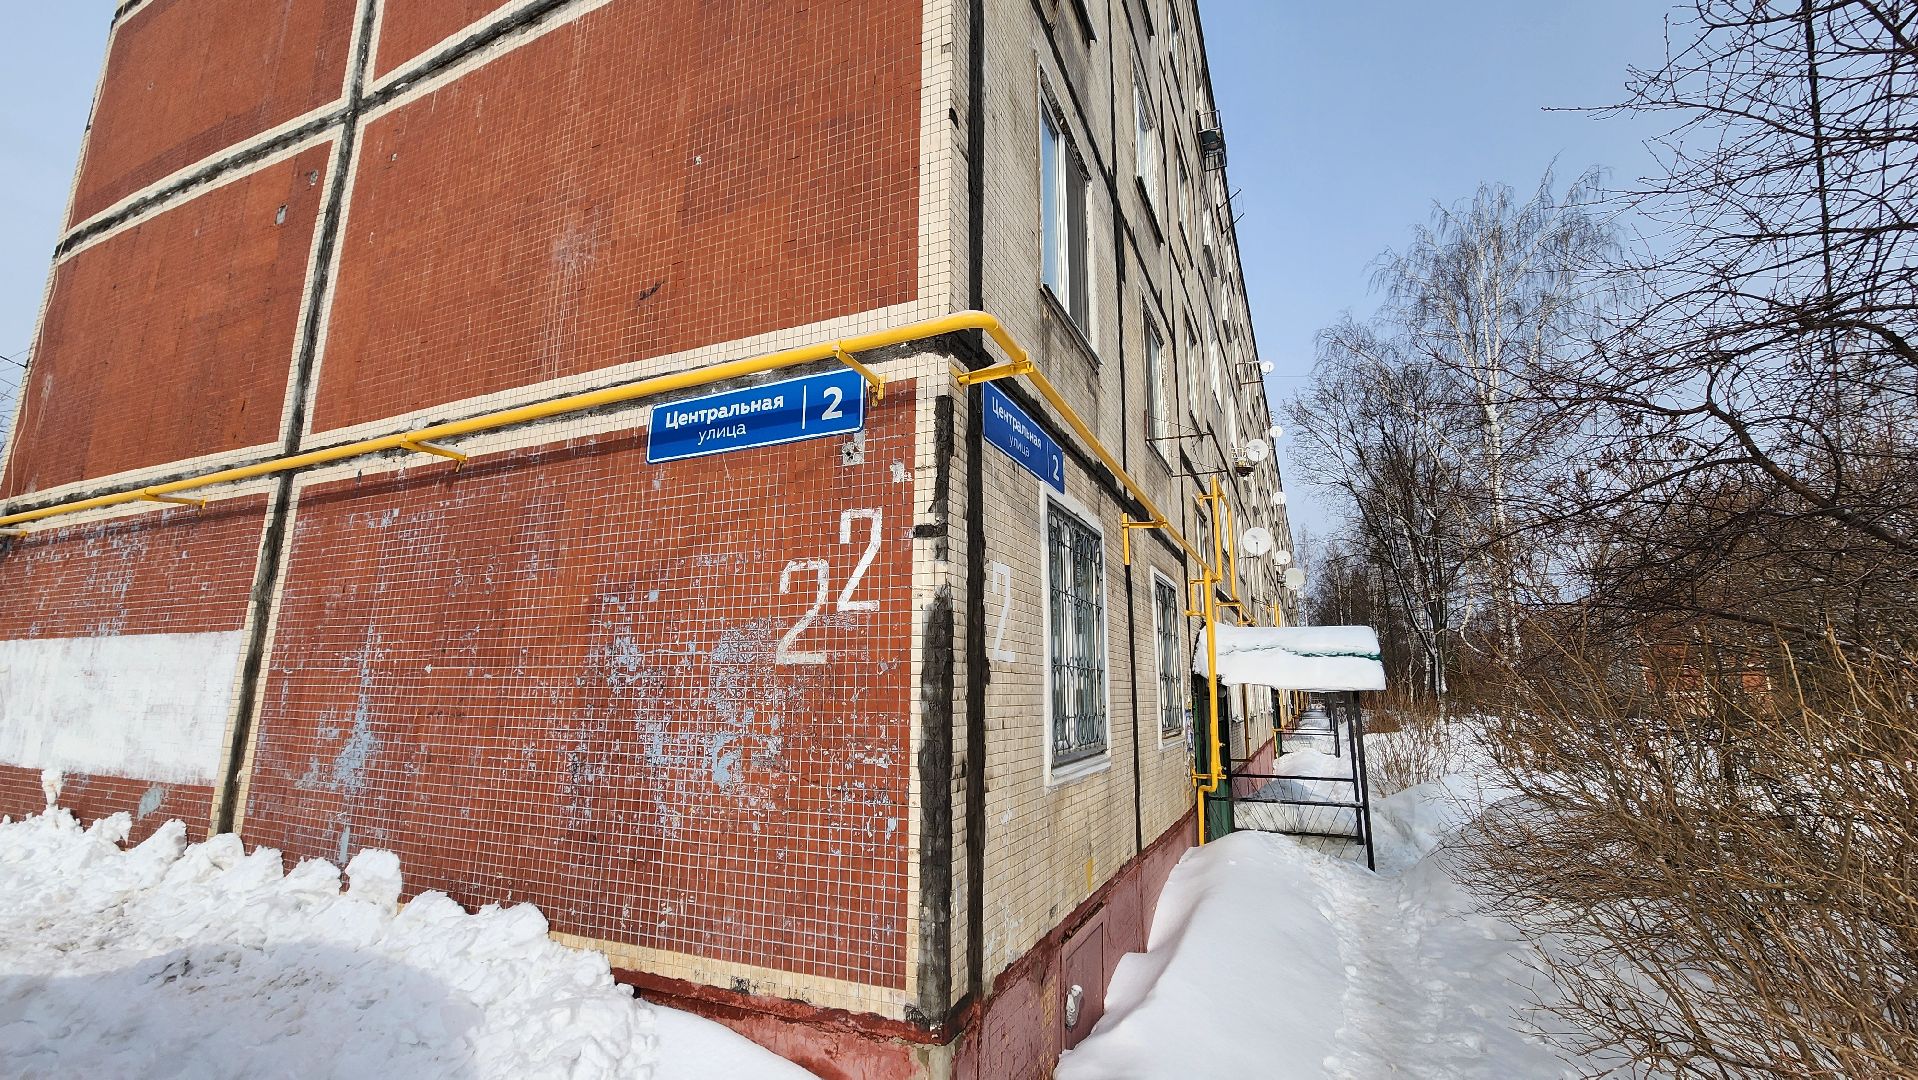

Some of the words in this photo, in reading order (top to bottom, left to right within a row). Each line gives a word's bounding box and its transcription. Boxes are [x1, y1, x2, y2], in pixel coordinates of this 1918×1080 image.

[665, 394, 784, 430] Центральная
[821, 387, 843, 421] 2
[697, 423, 747, 446] улица
[992, 396, 1042, 451] Центральная
[1052, 454, 1060, 482] 2
[1009, 435, 1030, 458] улица
[992, 560, 1016, 663] 2
